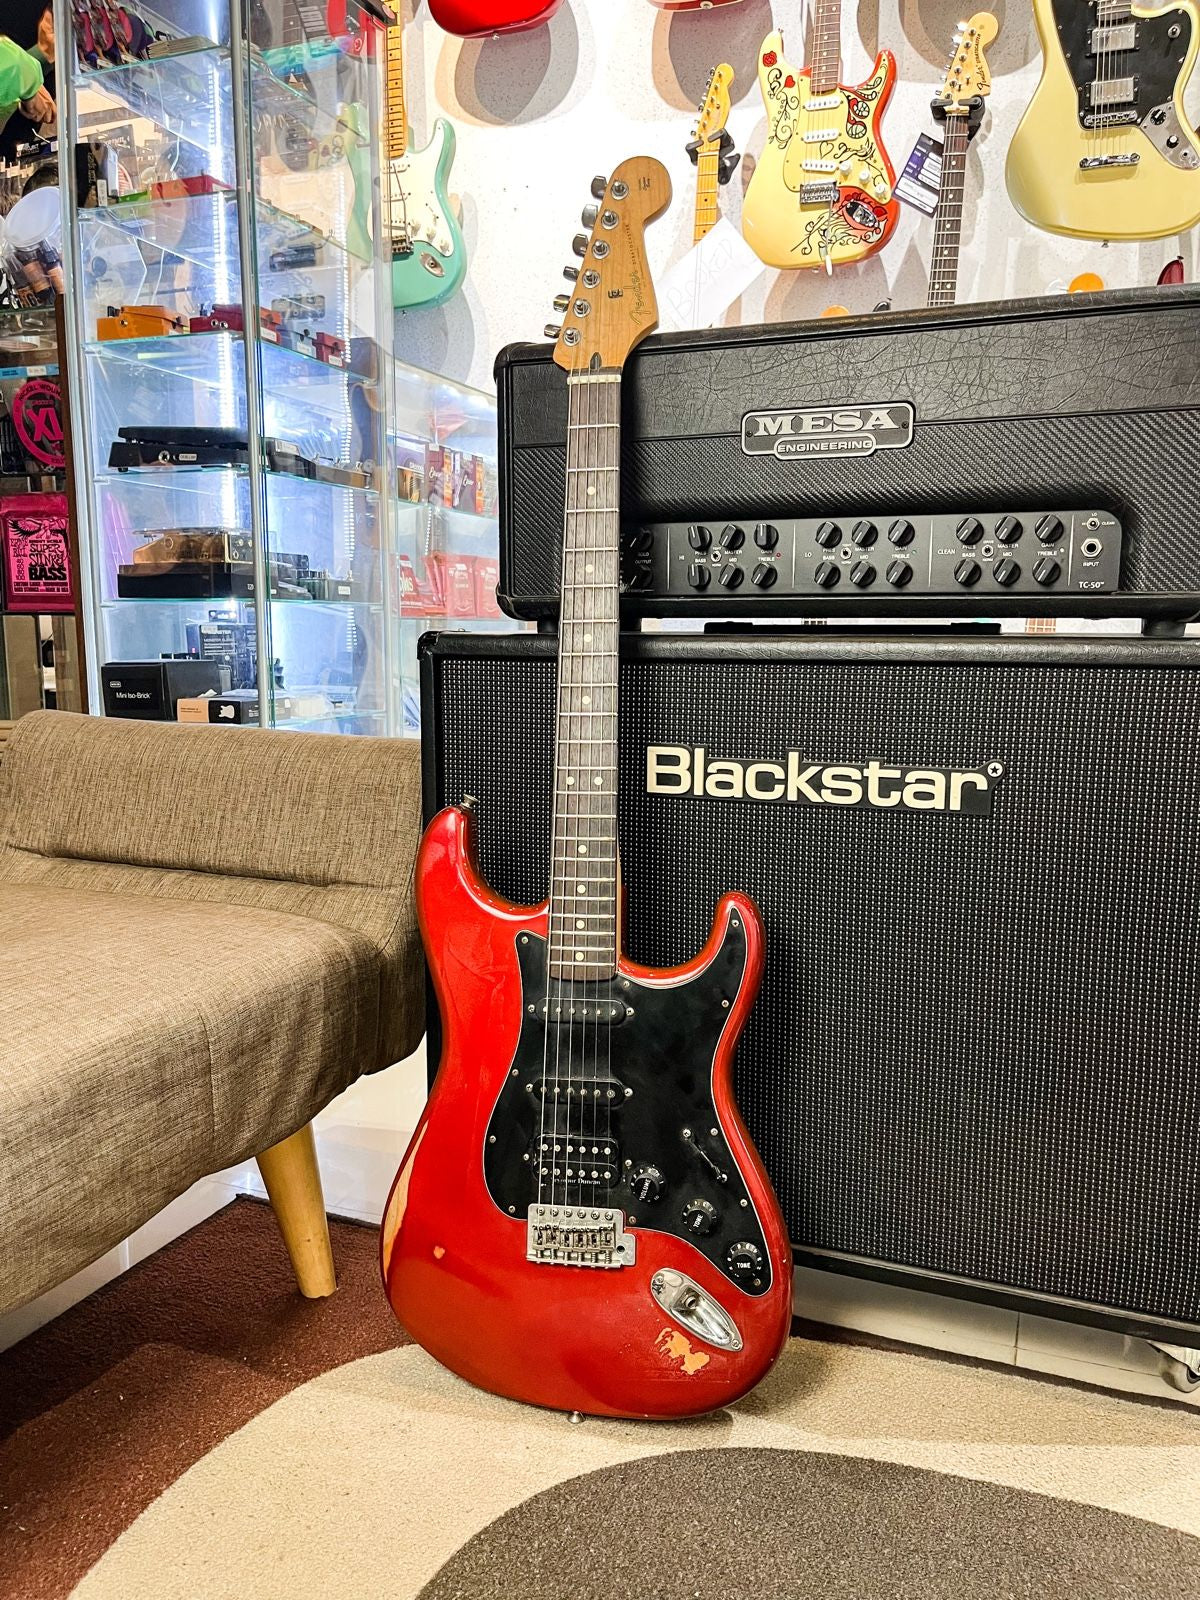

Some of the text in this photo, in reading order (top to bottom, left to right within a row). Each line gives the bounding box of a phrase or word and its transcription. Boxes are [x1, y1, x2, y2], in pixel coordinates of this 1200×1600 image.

[623, 270, 651, 325] Fender
[754, 408, 899, 437] MESA
[777, 439, 873, 453] ENGINEERING
[30, 543, 63, 553] SUPER
[29, 553, 67, 569] SLINKY
[28, 566, 67, 580] BASS
[116, 691, 127, 699] Mini
[646, 745, 989, 812] Blackstar
[577, 1177, 601, 1185] Duncan
[639, 1178, 652, 1201] VOLUME
[693, 1213, 704, 1228] TONE
